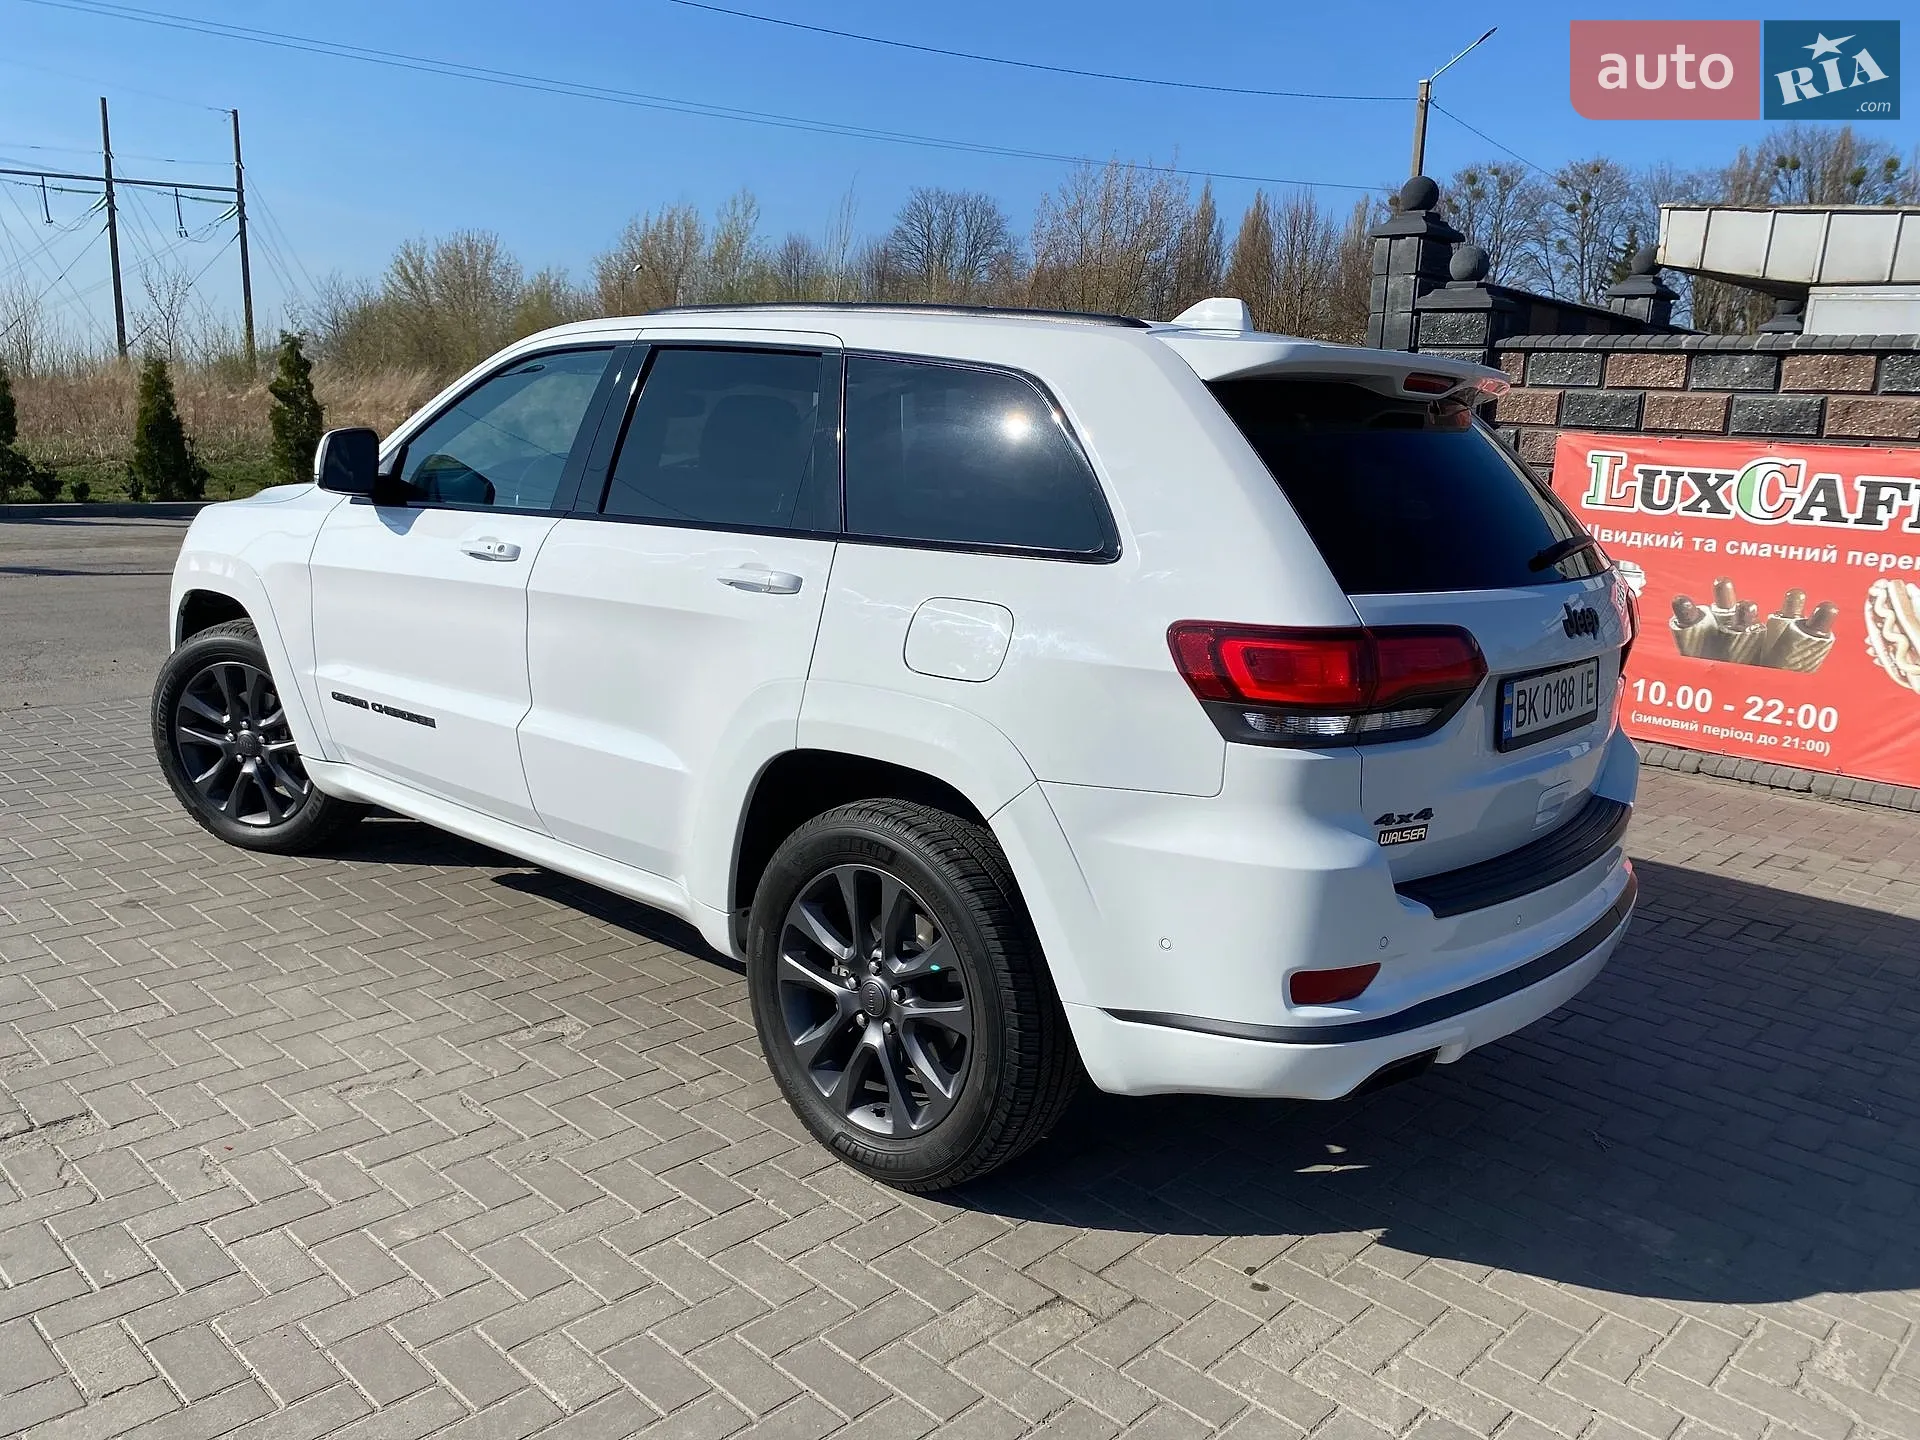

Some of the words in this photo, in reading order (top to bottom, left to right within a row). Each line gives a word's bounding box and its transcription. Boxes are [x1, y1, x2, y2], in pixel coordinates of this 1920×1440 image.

[1692, 537, 1718, 554] та
[1725, 540, 1838, 564] смачний
[1562, 602, 1600, 640] Jeep
[1515, 685, 1542, 729] BK
[1543, 675, 1575, 719] 0188
[1580, 669, 1595, 707] IE
[1632, 678, 1713, 714] 10.00
[1743, 695, 1838, 733] 22:00
[1630, 709, 1699, 733] (зимовий
[1702, 723, 1754, 744] період
[1756, 734, 1778, 746] до
[1782, 735, 1831, 757] 21:00)
[1374, 808, 1434, 826] 4x4
[1380, 828, 1426, 844] WALSER
